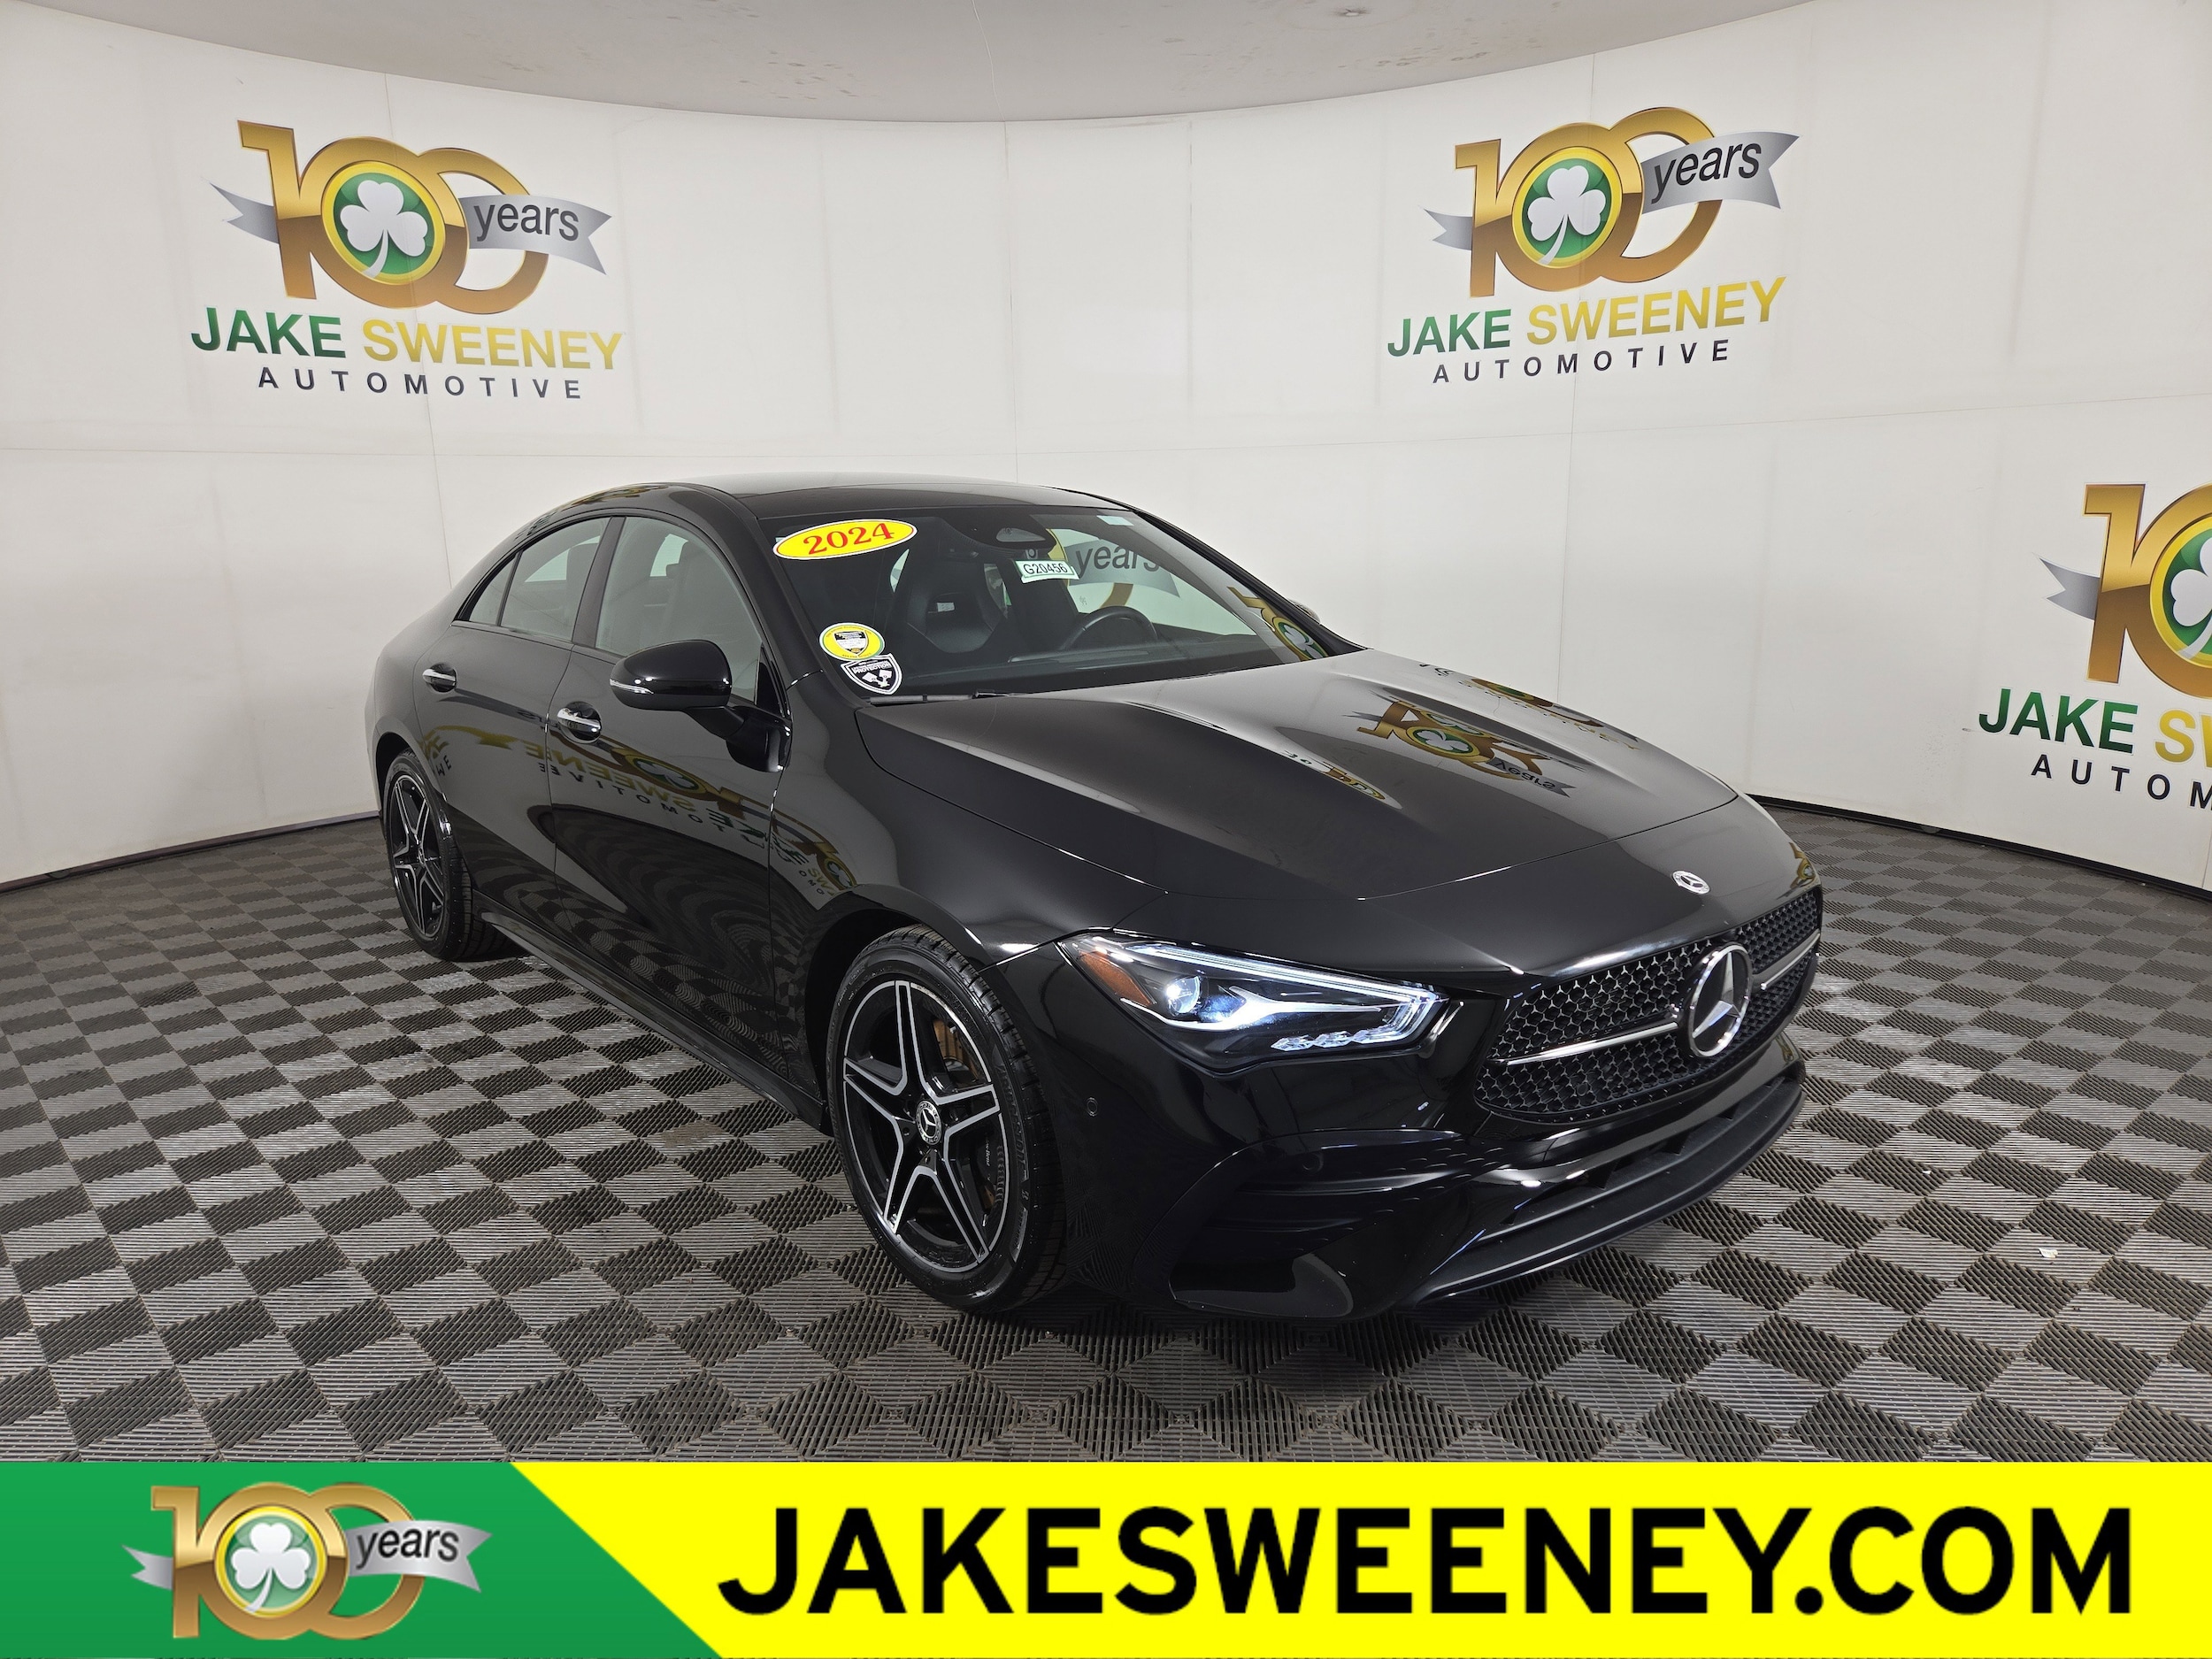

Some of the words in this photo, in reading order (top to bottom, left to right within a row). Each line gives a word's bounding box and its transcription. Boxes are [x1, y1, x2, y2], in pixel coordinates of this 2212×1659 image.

[237, 120, 549, 315] 100
[474, 202, 580, 242] years
[1455, 106, 1723, 297] 100
[1651, 142, 1762, 204] years
[191, 307, 346, 358] JAKE
[362, 319, 622, 370] SWEENEY
[1387, 309, 1511, 357] JAKE
[1527, 276, 1786, 345] SWEENEY
[258, 367, 580, 399] AUTOMOTIVE
[1432, 339, 1729, 384] AUTOMOTIVE
[803, 523, 895, 555] 2024
[1023, 563, 1068, 575] G20456
[1978, 688, 2139, 754] JAKE
[2155, 709, 2212, 768] S
